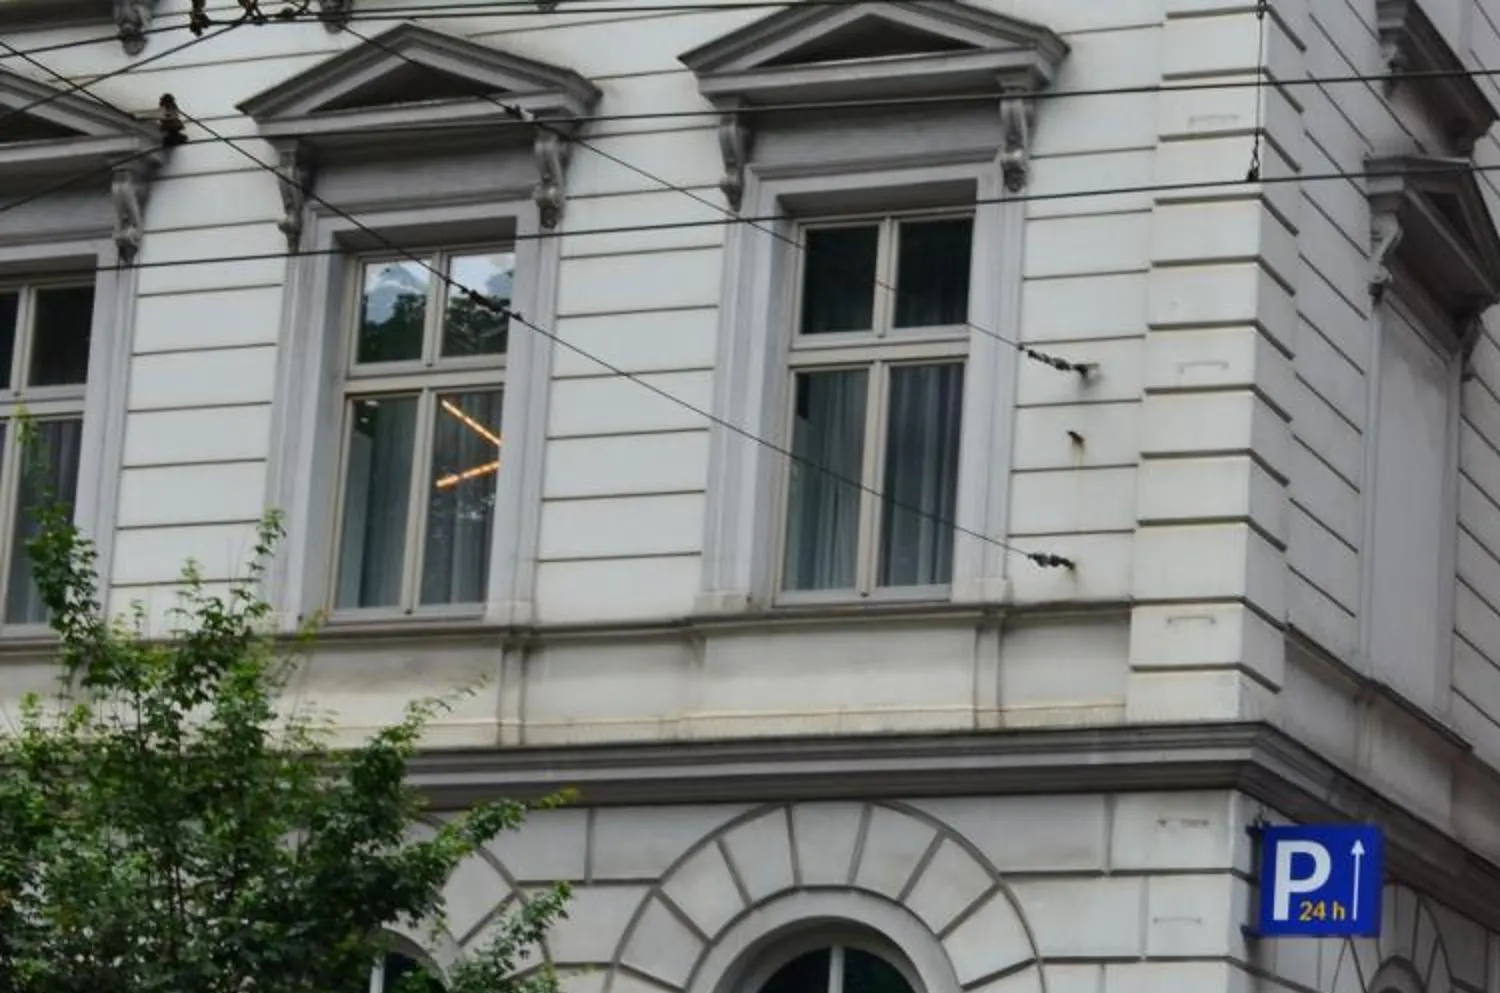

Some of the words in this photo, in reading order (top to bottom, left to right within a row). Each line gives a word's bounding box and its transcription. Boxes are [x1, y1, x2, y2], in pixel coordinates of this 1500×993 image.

[1273, 840, 1332, 921] P
[1299, 900, 1326, 921] 24
[1333, 900, 1346, 921] h
